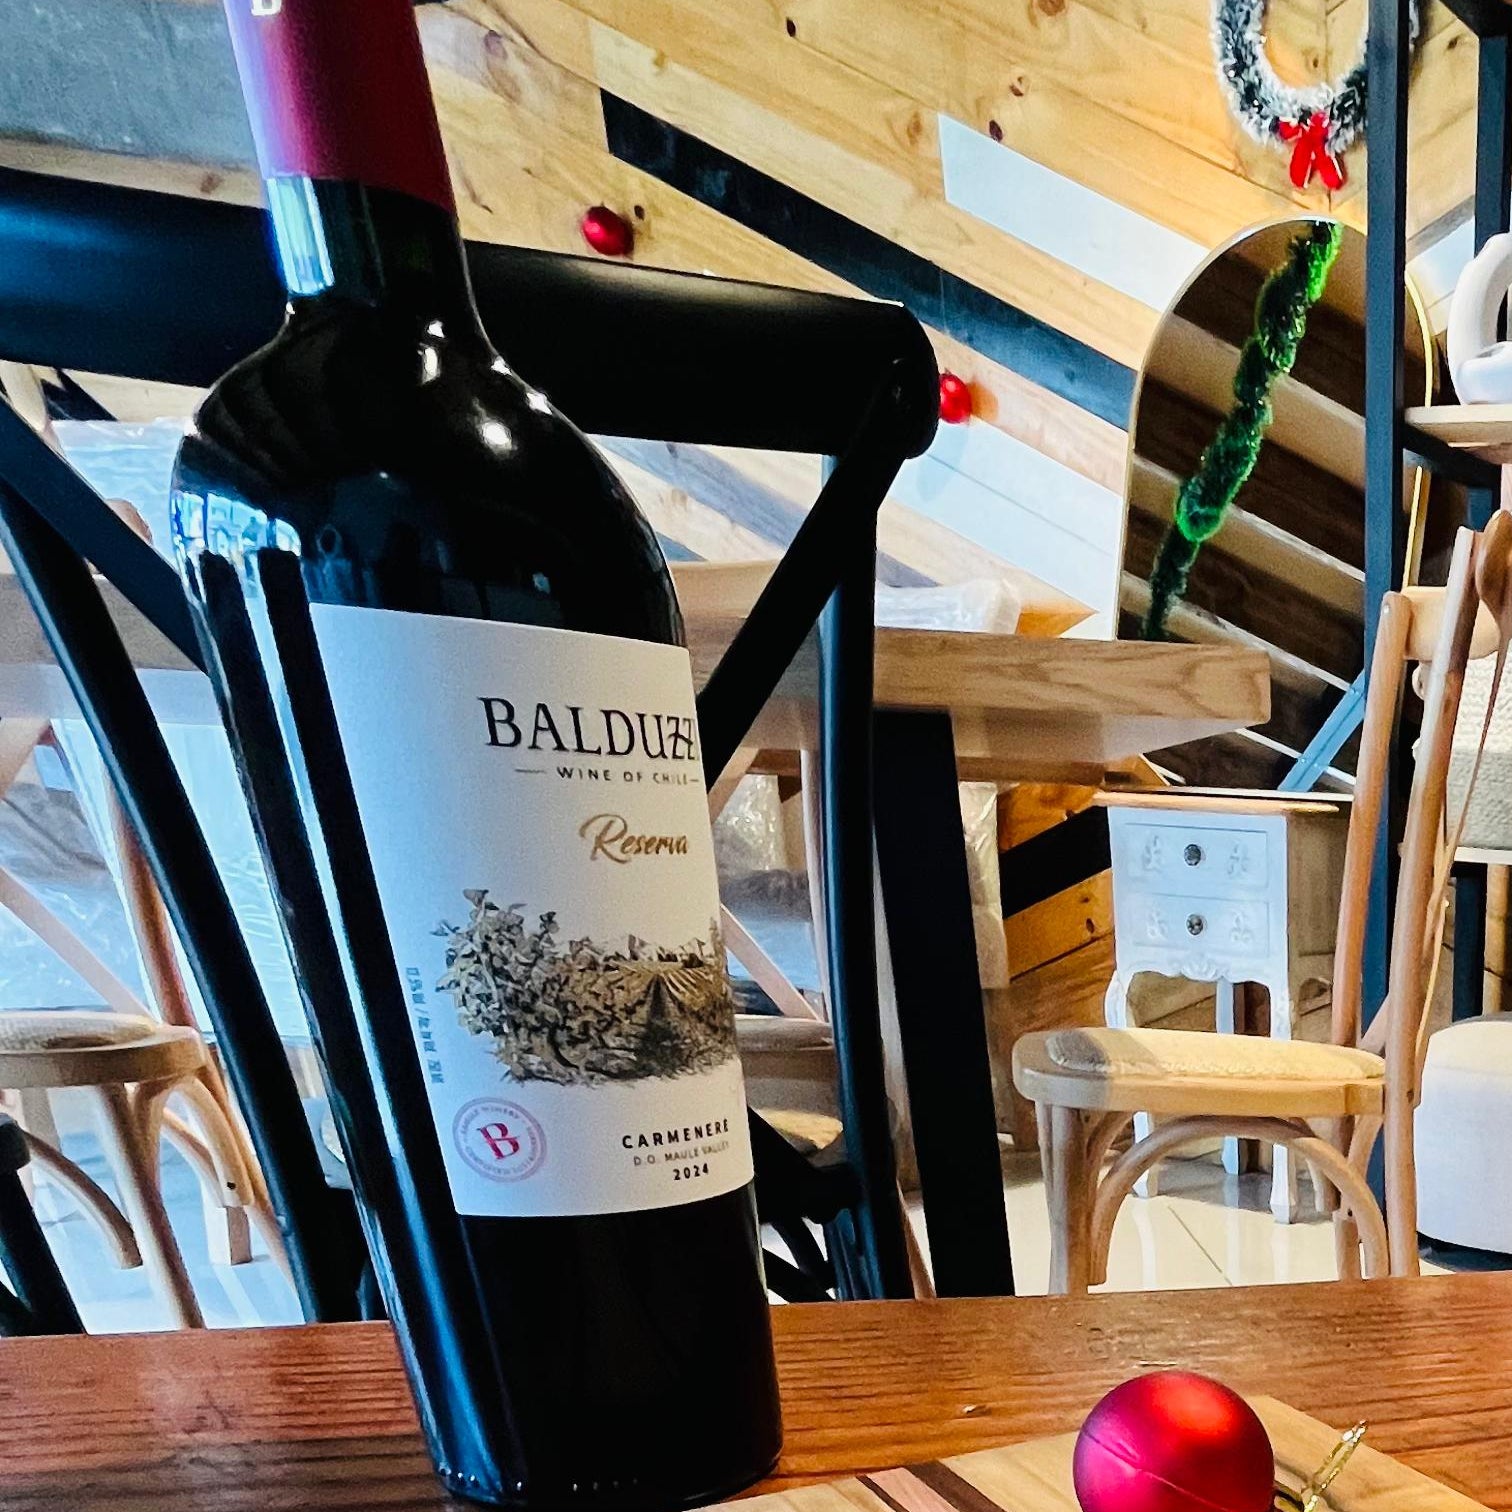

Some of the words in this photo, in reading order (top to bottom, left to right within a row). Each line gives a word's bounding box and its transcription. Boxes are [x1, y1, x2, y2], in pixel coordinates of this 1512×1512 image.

[477, 697, 699, 761] BALDUZZ
[556, 766, 612, 782] WINE
[623, 771, 642, 784] OF
[578, 814, 688, 865] Reserva
[622, 1118, 729, 1149] CARMENERE
[665, 1147, 699, 1162] MAULE
[673, 1162, 709, 1181] 2024
